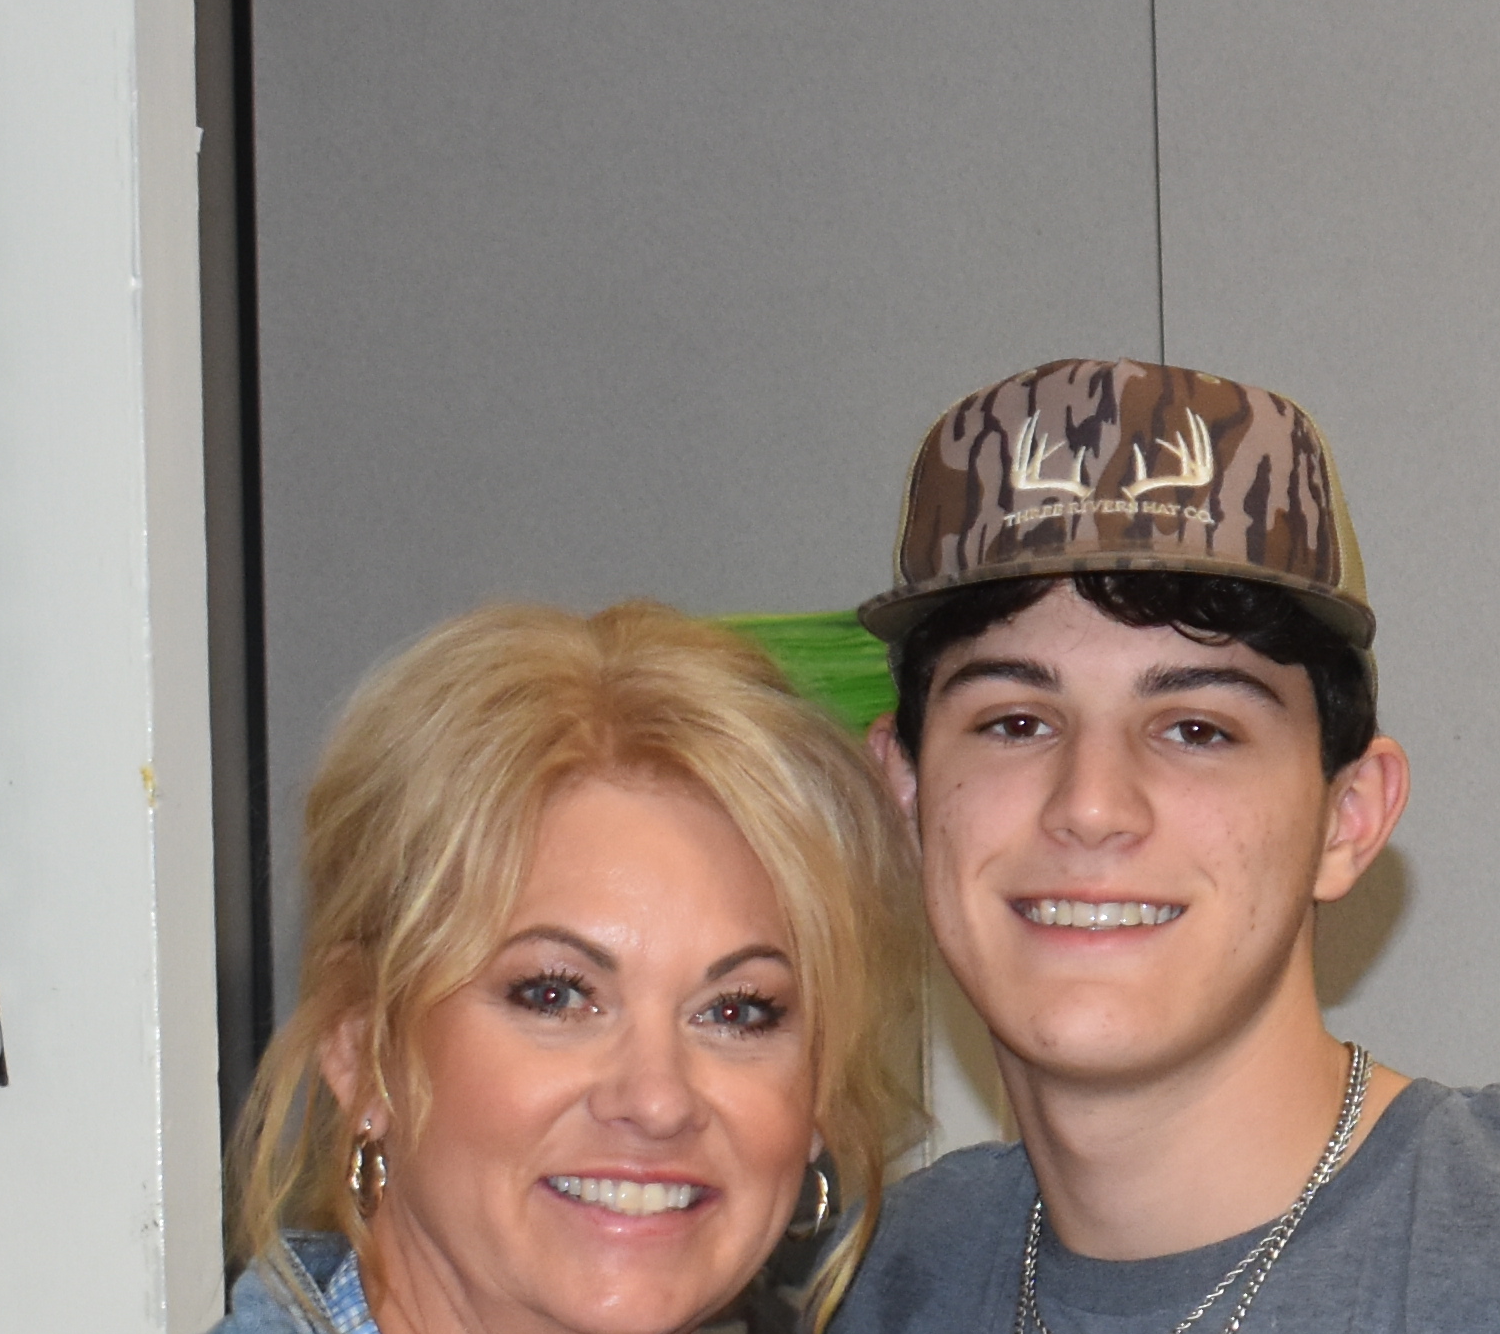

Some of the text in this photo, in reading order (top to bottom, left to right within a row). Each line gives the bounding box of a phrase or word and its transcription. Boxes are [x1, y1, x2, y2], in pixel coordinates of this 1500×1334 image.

[1003, 503, 1064, 527] THREE
[1066, 499, 1139, 516] RIVERS
[1143, 501, 1181, 516] HAT
